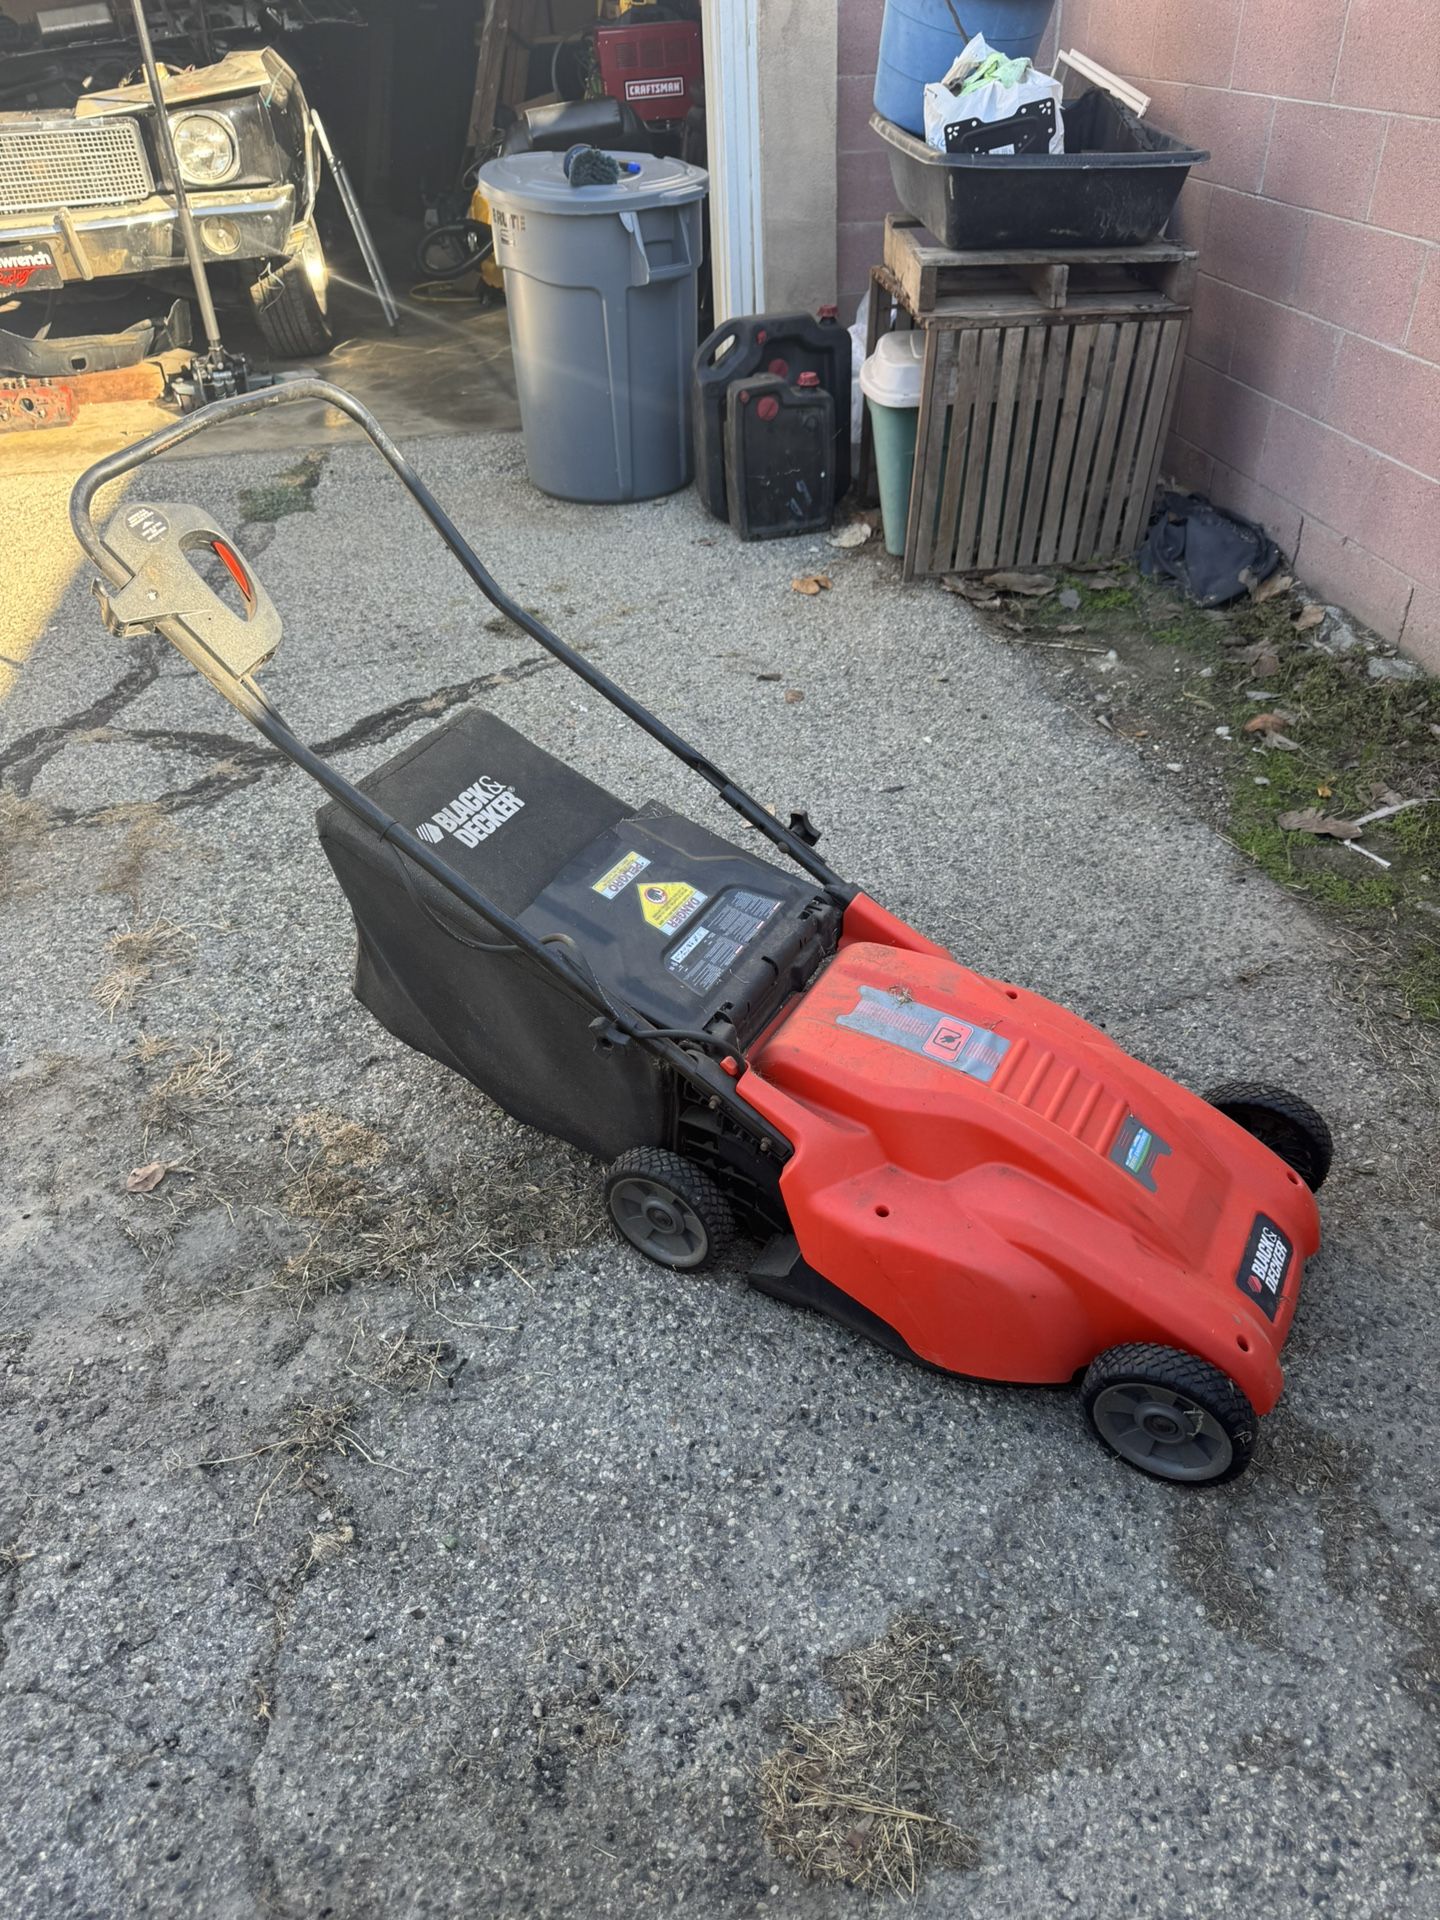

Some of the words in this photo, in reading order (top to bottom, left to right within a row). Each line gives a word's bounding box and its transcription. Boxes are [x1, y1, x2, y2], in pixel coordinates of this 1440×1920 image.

[629, 81, 681, 96] CRAFTSMAN
[608, 862, 643, 892] PELIGRO
[667, 897, 700, 928] DANGER
[1265, 1239, 1287, 1294] DECKER
